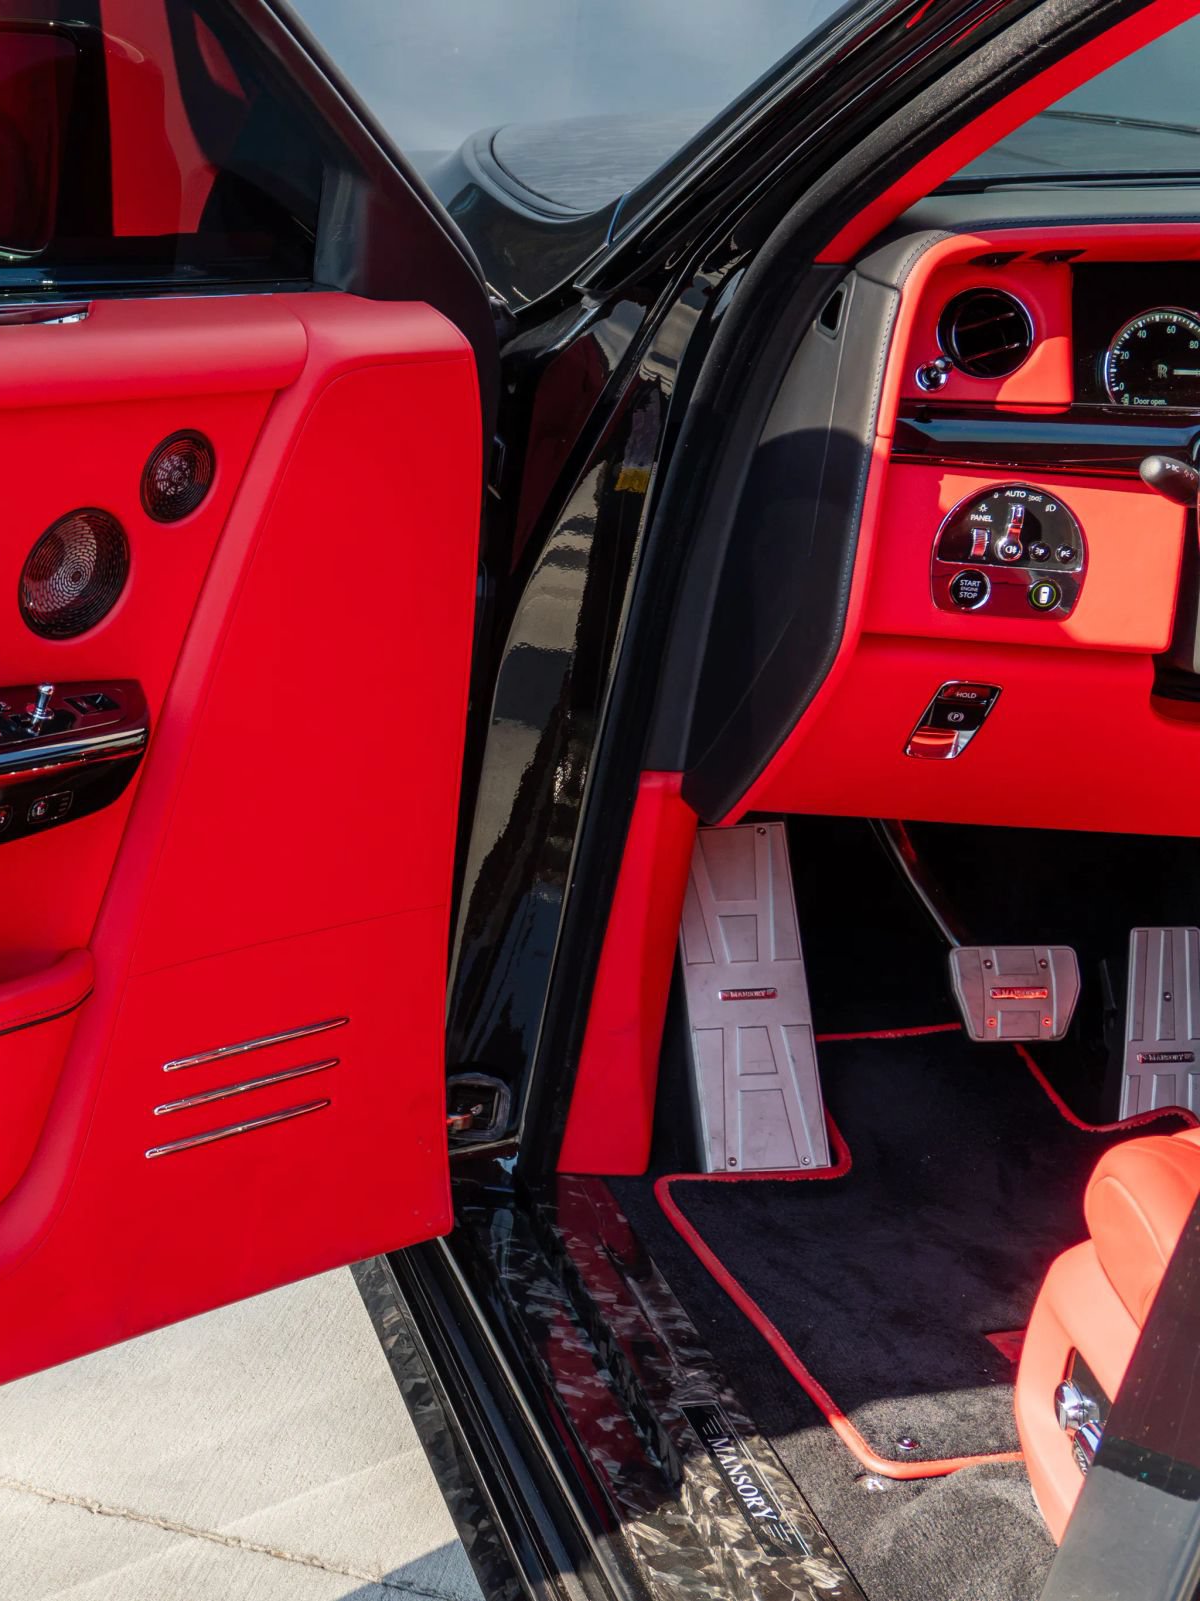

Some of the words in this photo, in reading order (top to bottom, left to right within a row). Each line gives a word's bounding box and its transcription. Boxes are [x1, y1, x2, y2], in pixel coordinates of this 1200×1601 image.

[1137, 329, 1147, 338] 40
[1166, 325, 1176, 334] 60
[1189, 340, 1199, 349] 80
[1120, 351, 1130, 360] 20
[1119, 382, 1125, 391] 0
[1133, 397, 1149, 405] Door
[1004, 490, 1027, 498] AUTO
[970, 514, 993, 522] PANEL
[959, 591, 978, 599] STOP
[707, 1437, 778, 1521] MANSORY
